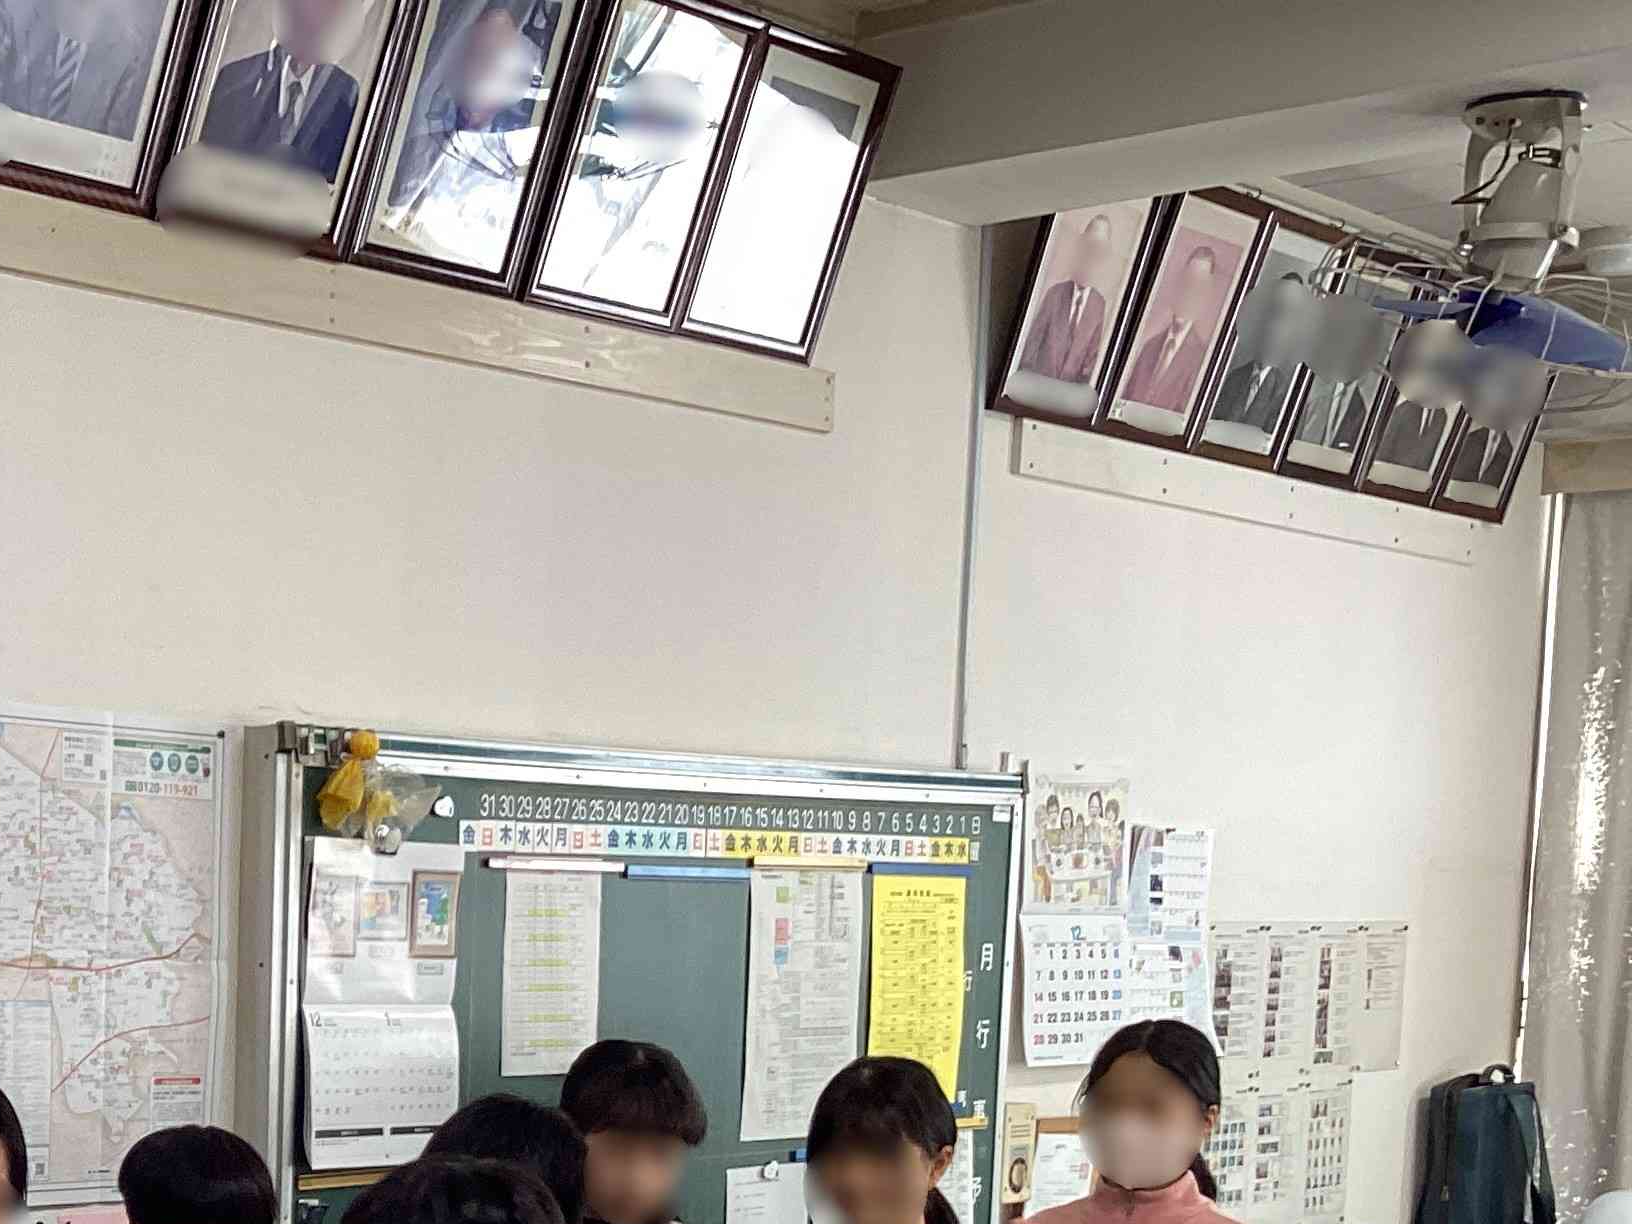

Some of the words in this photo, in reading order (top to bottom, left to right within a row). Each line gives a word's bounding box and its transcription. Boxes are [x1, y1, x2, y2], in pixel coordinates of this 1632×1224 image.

[480, 794, 495, 816] 31
[499, 795, 514, 817] 30
[517, 796, 532, 818] 29
[536, 797, 551, 818] 28
[554, 798, 569, 819] 27
[572, 799, 586, 820] 26
[590, 800, 604, 820] 25
[607, 800, 621, 821] 24
[624, 802, 638, 822] 23
[642, 802, 655, 823] 22
[658, 803, 672, 824] 21
[674, 804, 689, 824] 20
[692, 805, 704, 825] 19
[708, 806, 721, 825] 18
[724, 806, 737, 825] 17
[740, 806, 752, 827] 16
[756, 808, 768, 827] 15
[771, 808, 784, 827] 14
[788, 809, 799, 828] 13
[802, 810, 814, 829] 12
[818, 810, 828, 828] 11
[832, 811, 843, 830] 10
[848, 811, 856, 830] 9
[862, 812, 870, 831] 8
[878, 812, 885, 832] 7
[892, 813, 899, 832] 6
[906, 813, 913, 832] 5
[920, 814, 927, 832] 4
[933, 815, 940, 833] 3
[946, 815, 953, 834] 2
[960, 816, 965, 833] 1
[463, 825, 475, 844] 金
[482, 828, 492, 846] 日
[500, 824, 512, 844] 木
[518, 826, 530, 846] 水
[537, 826, 549, 846] 火
[555, 828, 567, 846] 月
[573, 832, 583, 849] 日
[590, 829, 602, 847] 土
[608, 830, 619, 848] 金
[625, 830, 636, 848] 木
[642, 830, 653, 849] 水
[660, 832, 670, 850] 火
[676, 832, 687, 850] 月
[693, 833, 702, 850] 日
[709, 832, 720, 851] 土
[726, 834, 736, 851] 金
[741, 835, 752, 852] 木
[757, 836, 767, 852] 水
[773, 835, 782, 853] 火
[788, 836, 798, 854] 月
[804, 837, 812, 853] 日
[817, 838, 828, 854] 土
[832, 838, 842, 854] 金
[847, 838, 856, 854] 木
[862, 838, 871, 856] 水
[876, 840, 886, 856] 火
[890, 840, 900, 856] 月
[905, 840, 913, 856] 日
[917, 840, 926, 856] 土
[931, 841, 940, 857] 金
[945, 842, 953, 856] 木
[957, 842, 966, 858] 水
[980, 943, 994, 971] 月
[976, 1020, 990, 1049] 行
